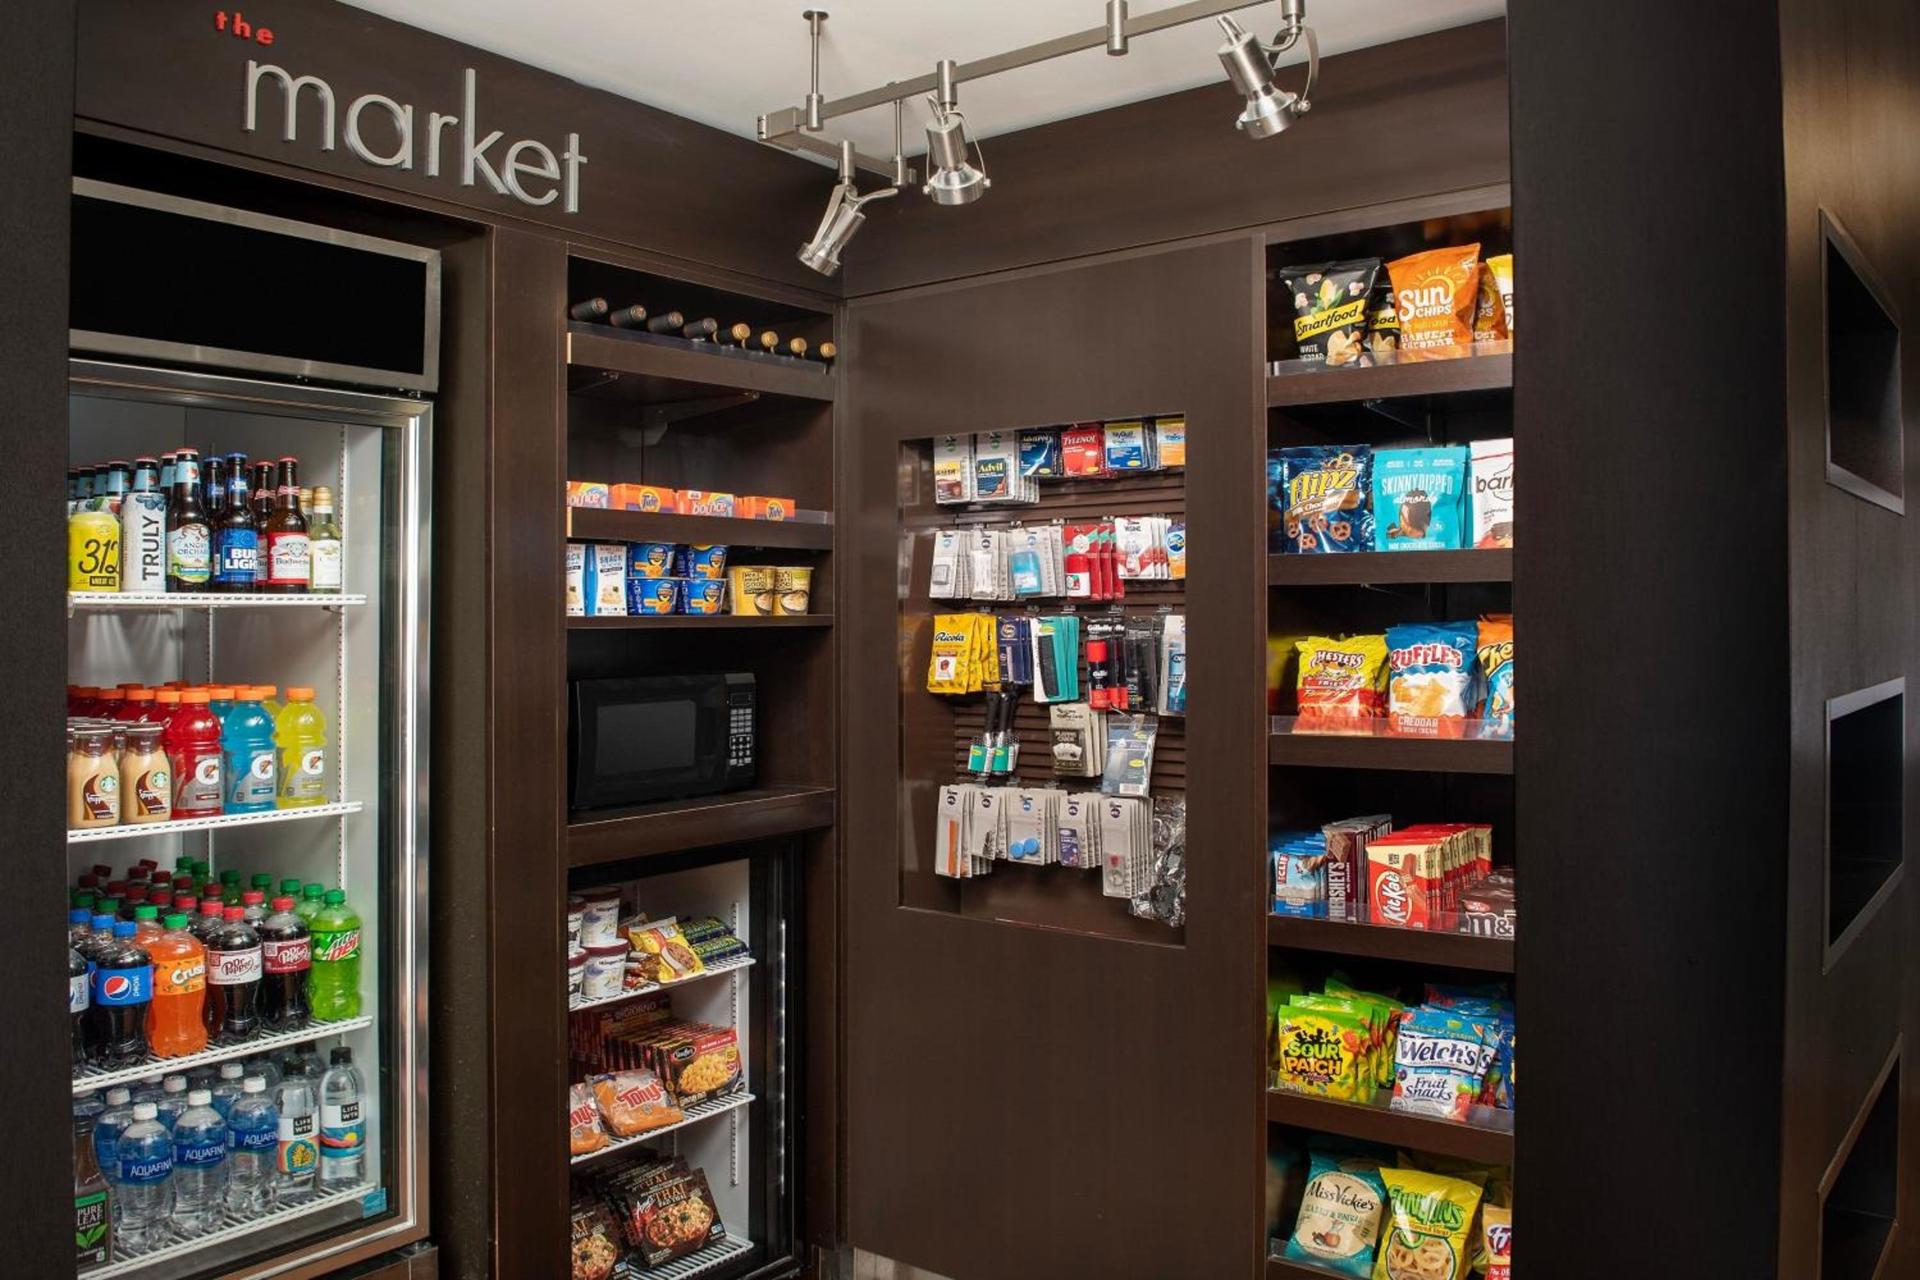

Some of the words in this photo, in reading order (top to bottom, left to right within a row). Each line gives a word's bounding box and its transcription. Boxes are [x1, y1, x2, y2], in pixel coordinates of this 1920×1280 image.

[214, 10, 274, 46] the
[242, 59, 588, 213] market
[1398, 286, 1453, 322] Sun
[1414, 305, 1452, 318] CHIPS
[1296, 305, 1360, 338] Smartfood
[1400, 329, 1454, 343] HARVEST
[1062, 434, 1097, 446] TYLENOL
[979, 462, 1004, 473] Advil
[642, 494, 659, 508] Tide
[142, 515, 160, 581] TRULY
[225, 558, 258, 570] LIGH
[935, 632, 966, 642] Ricola
[1390, 643, 1462, 673] RUFFLES
[1398, 716, 1439, 727] CHEDDAR
[1327, 861, 1347, 917] HERSHEY'S
[222, 960, 253, 976] Pepper
[1288, 1040, 1340, 1060] SOUR
[1399, 1039, 1477, 1067] Welch's
[1285, 1056, 1343, 1077] PATCH
[1403, 1084, 1454, 1102] Snacks
[1414, 1077, 1449, 1090] Fruit
[655, 1183, 688, 1203] THAI
[1306, 1181, 1336, 1200] Miss
[1334, 1183, 1378, 1212] Vickie's
